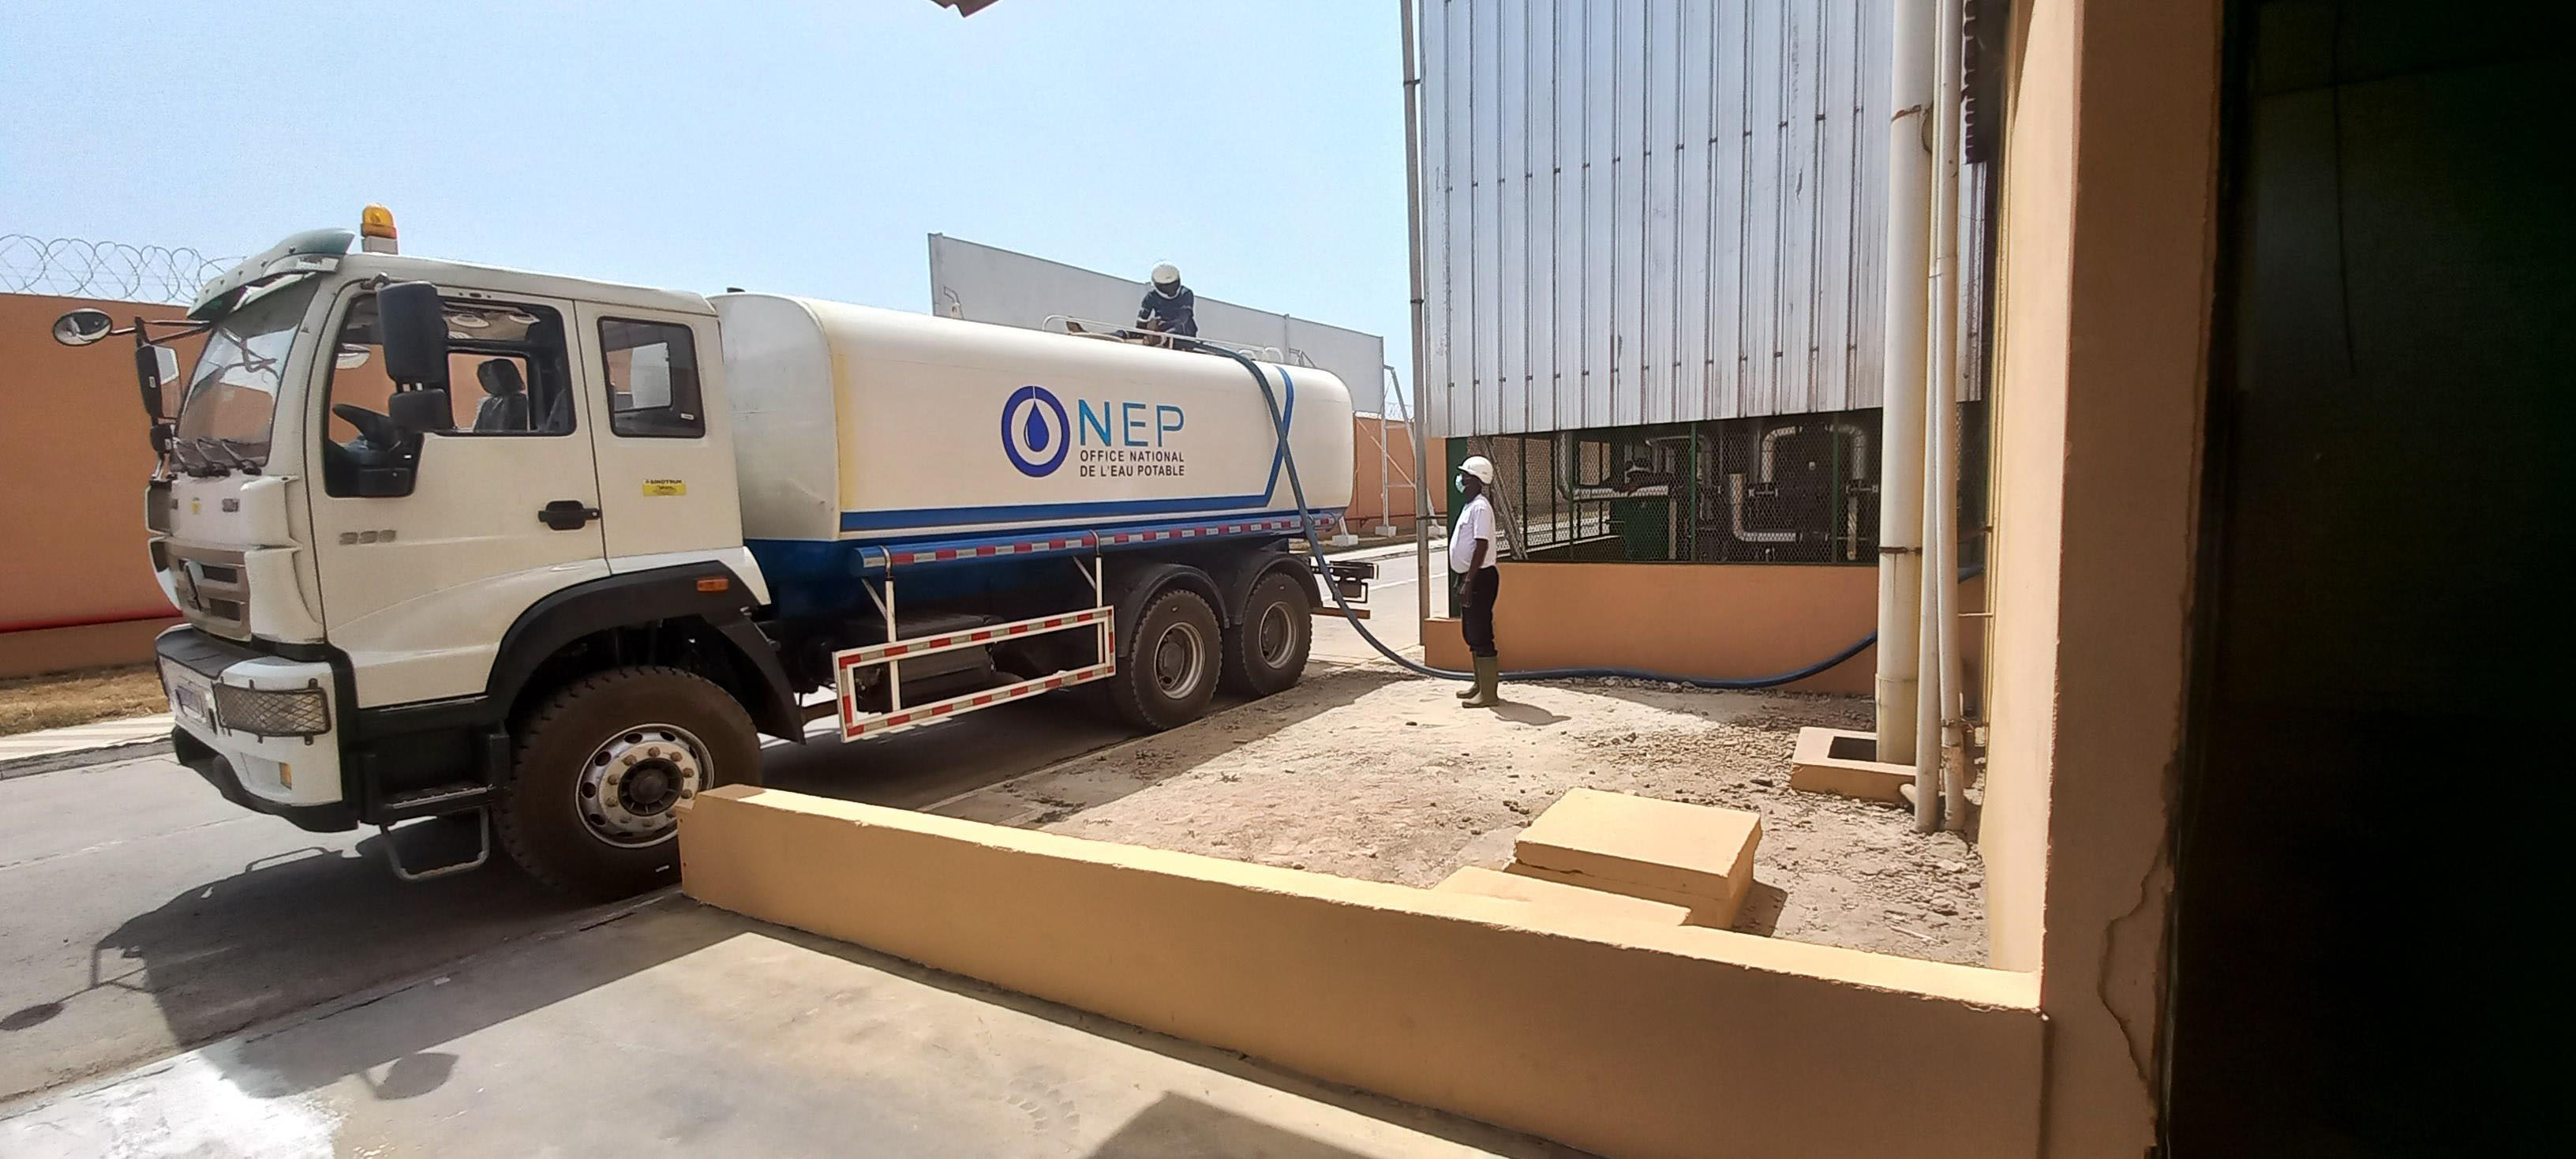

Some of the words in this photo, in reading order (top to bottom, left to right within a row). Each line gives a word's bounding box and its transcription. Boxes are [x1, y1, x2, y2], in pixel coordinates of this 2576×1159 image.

[1001, 385, 1185, 478] ONEP
[1080, 450, 1125, 463] OFFICE
[1129, 450, 1185, 463] NATIONAL
[1080, 465, 1095, 477] DE
[1100, 465, 1133, 477] L'EAU
[1137, 464, 1185, 476] POTABLE
